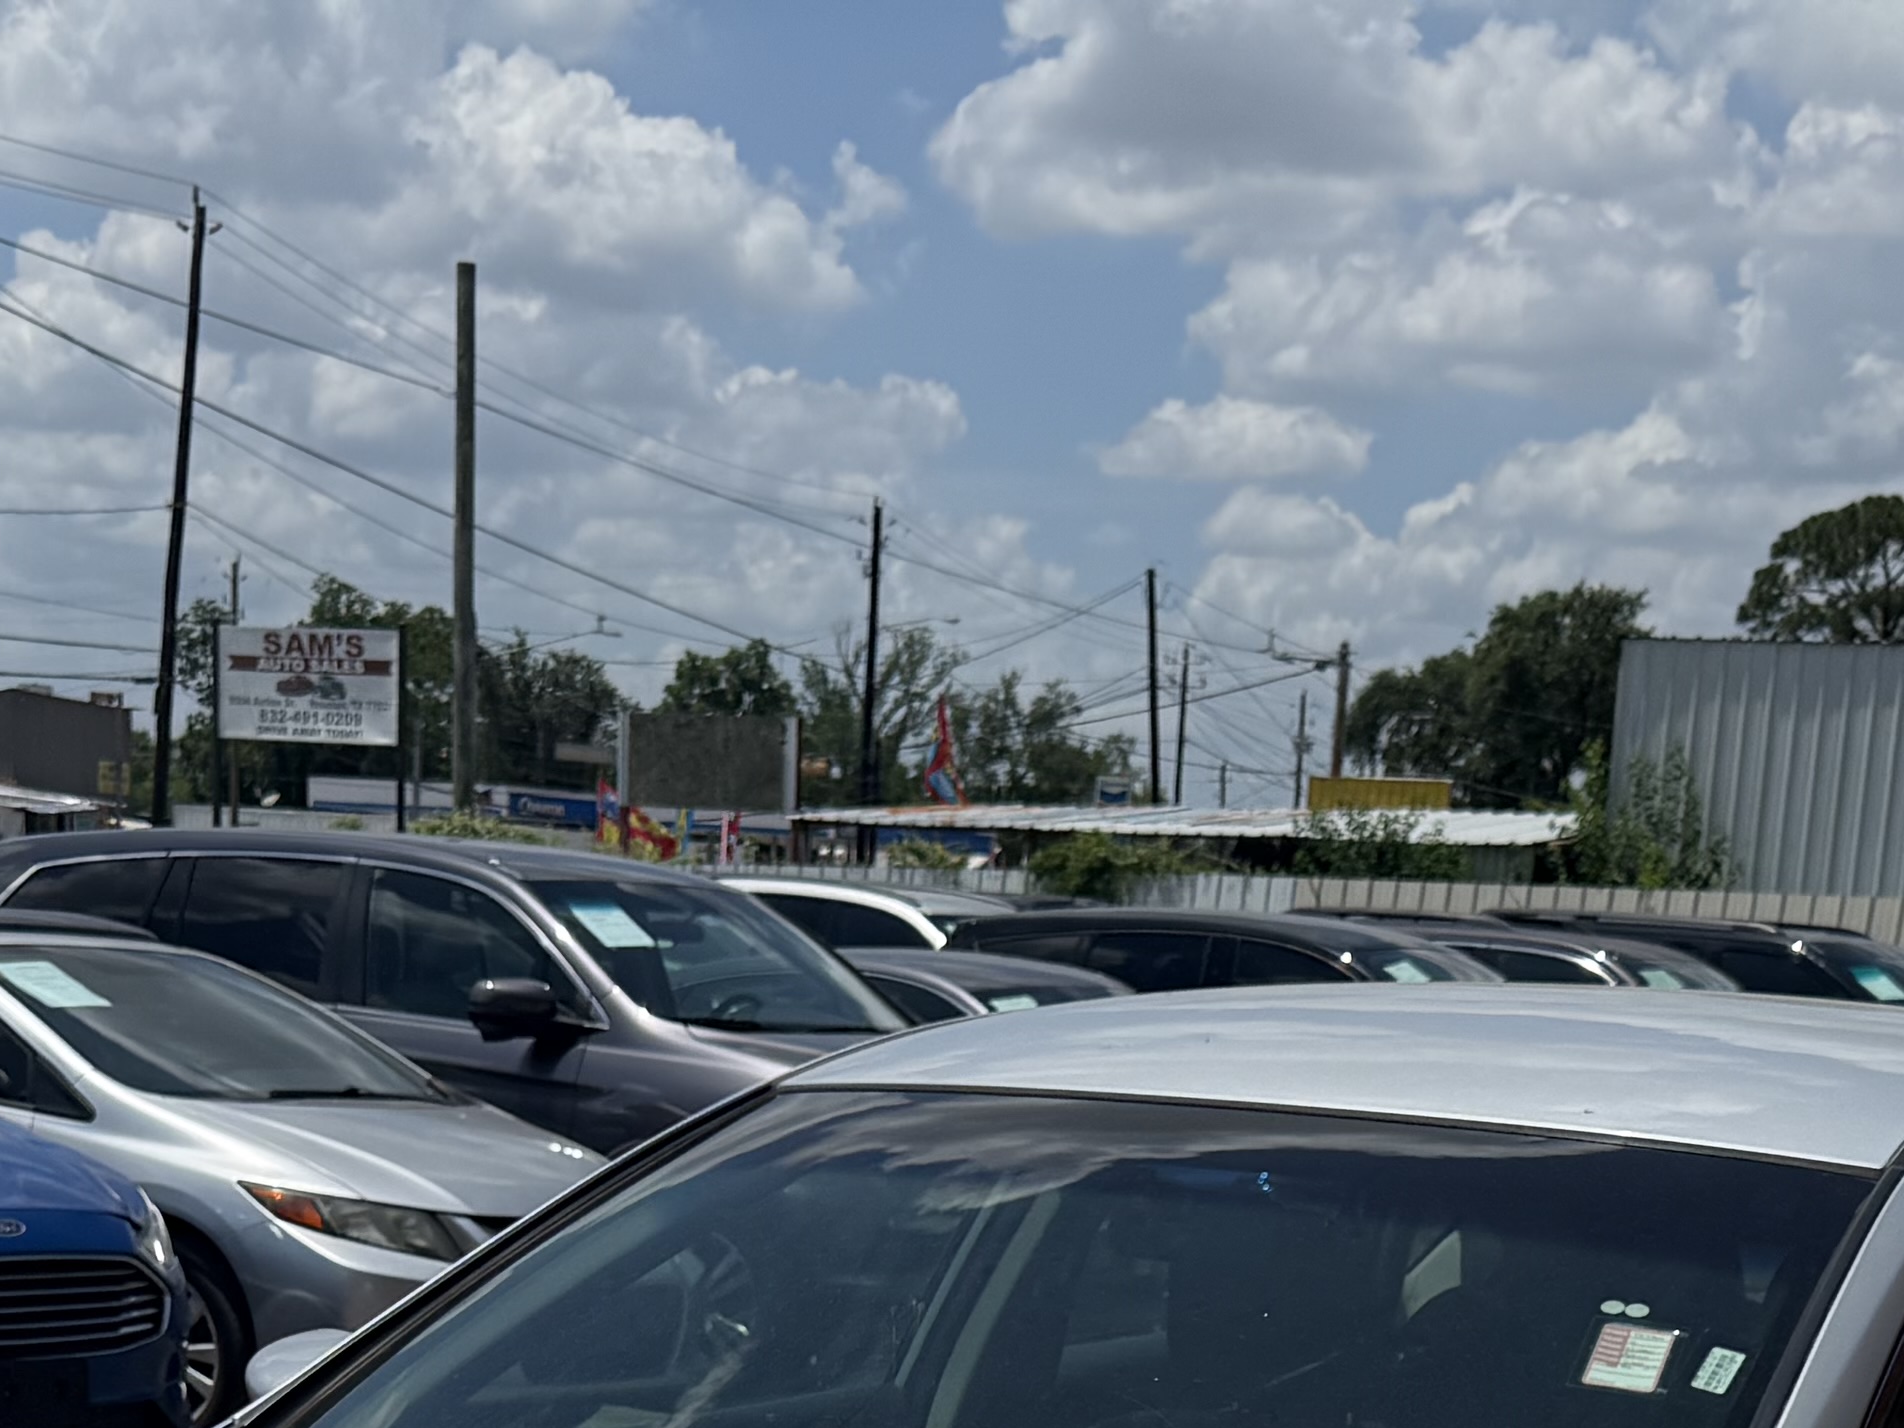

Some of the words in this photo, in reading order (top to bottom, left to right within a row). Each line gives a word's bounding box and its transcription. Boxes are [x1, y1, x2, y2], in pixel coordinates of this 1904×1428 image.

[263, 631, 365, 658] SAM'S
[257, 658, 306, 673] AUTO
[309, 659, 366, 674] SALES
